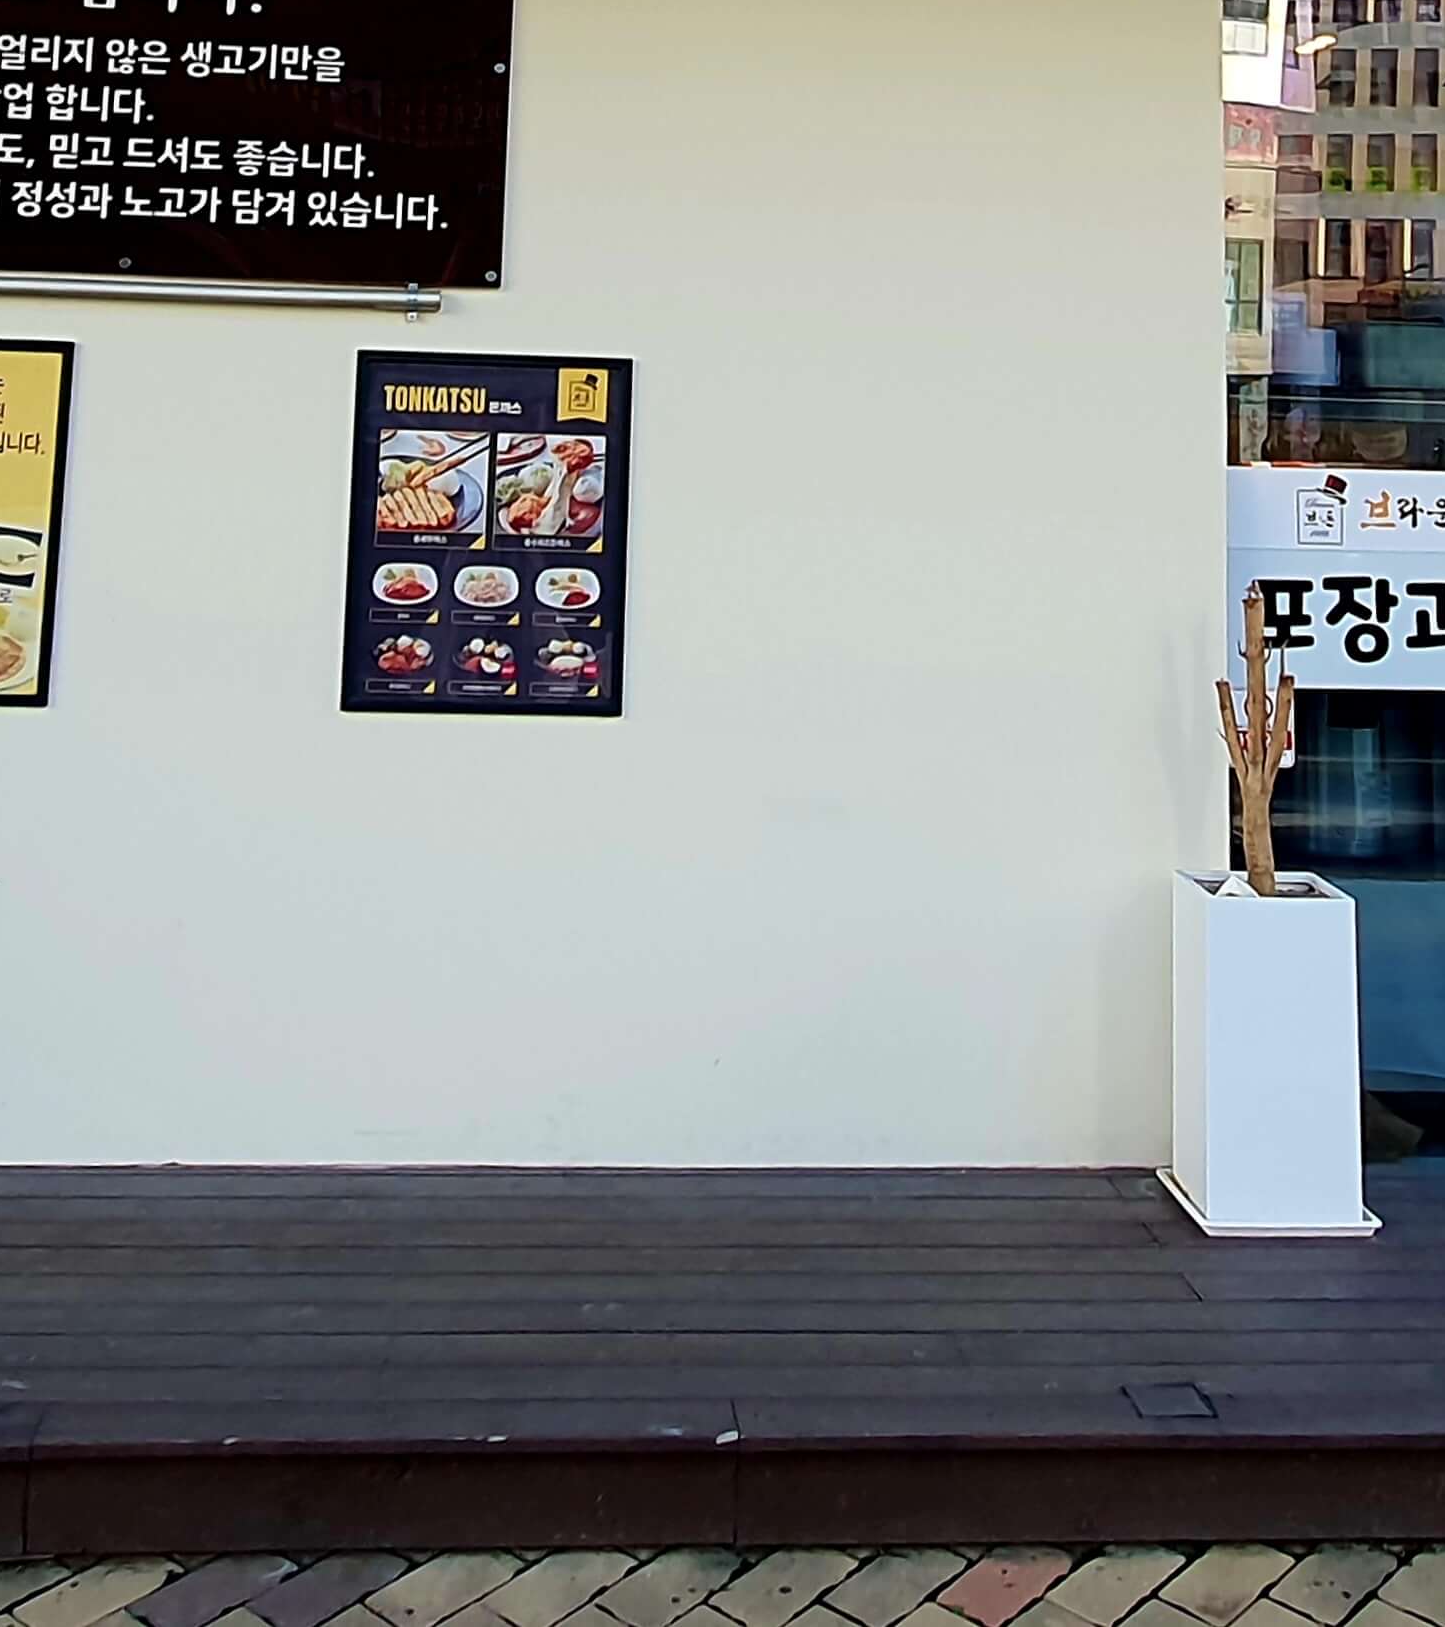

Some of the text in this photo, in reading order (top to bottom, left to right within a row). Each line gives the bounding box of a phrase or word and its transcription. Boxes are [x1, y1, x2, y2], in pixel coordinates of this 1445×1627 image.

[105, 37, 171, 76] 않은
[179, 42, 346, 83] 생고기만을
[44, 83, 155, 124] 합니다.
[48, 133, 115, 171] 믿고
[123, 136, 224, 173] 드셔도
[233, 139, 375, 179] 좋습니다.
[10, 179, 113, 219] 정성과
[120, 184, 222, 223] 노고가
[232, 187, 295, 227] 담겨
[306, 189, 449, 231] 있습니다.
[383, 384, 487, 414] TONKATSU
